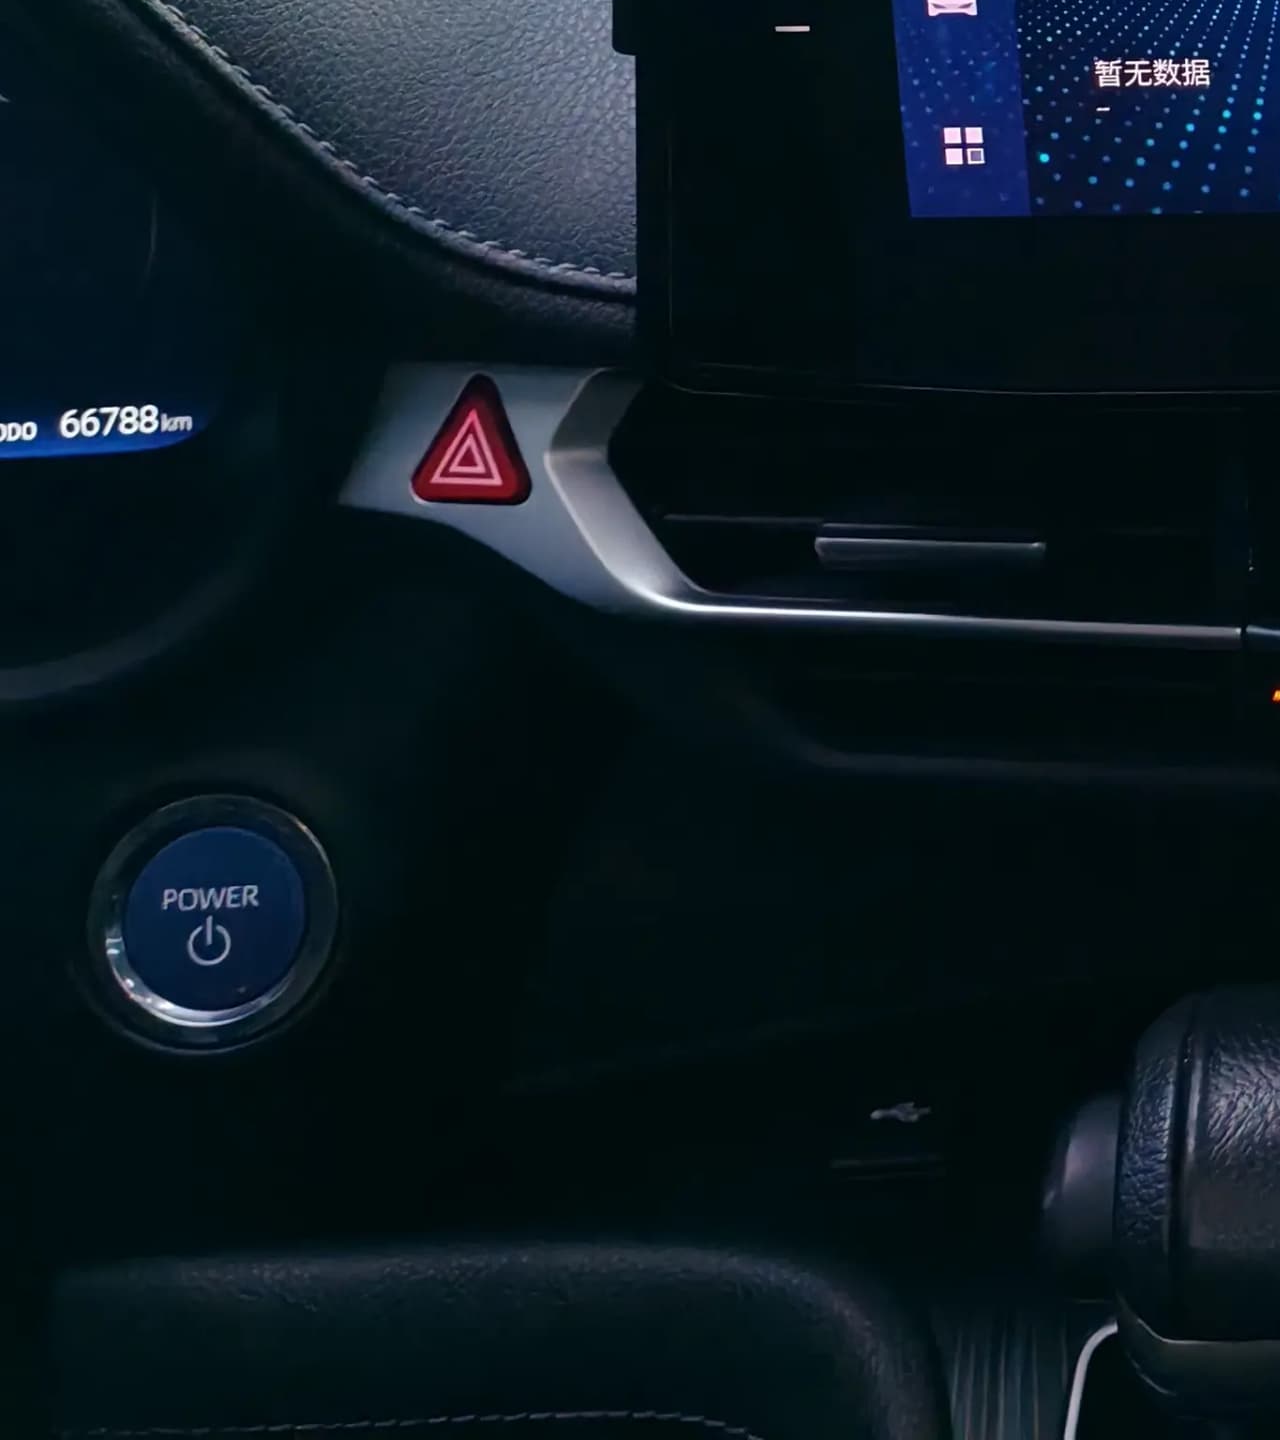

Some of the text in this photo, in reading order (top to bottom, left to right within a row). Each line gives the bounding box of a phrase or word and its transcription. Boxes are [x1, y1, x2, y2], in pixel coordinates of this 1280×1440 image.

[1094, 58, 1211, 88] 暂无数据
[161, 884, 260, 911] POWER
